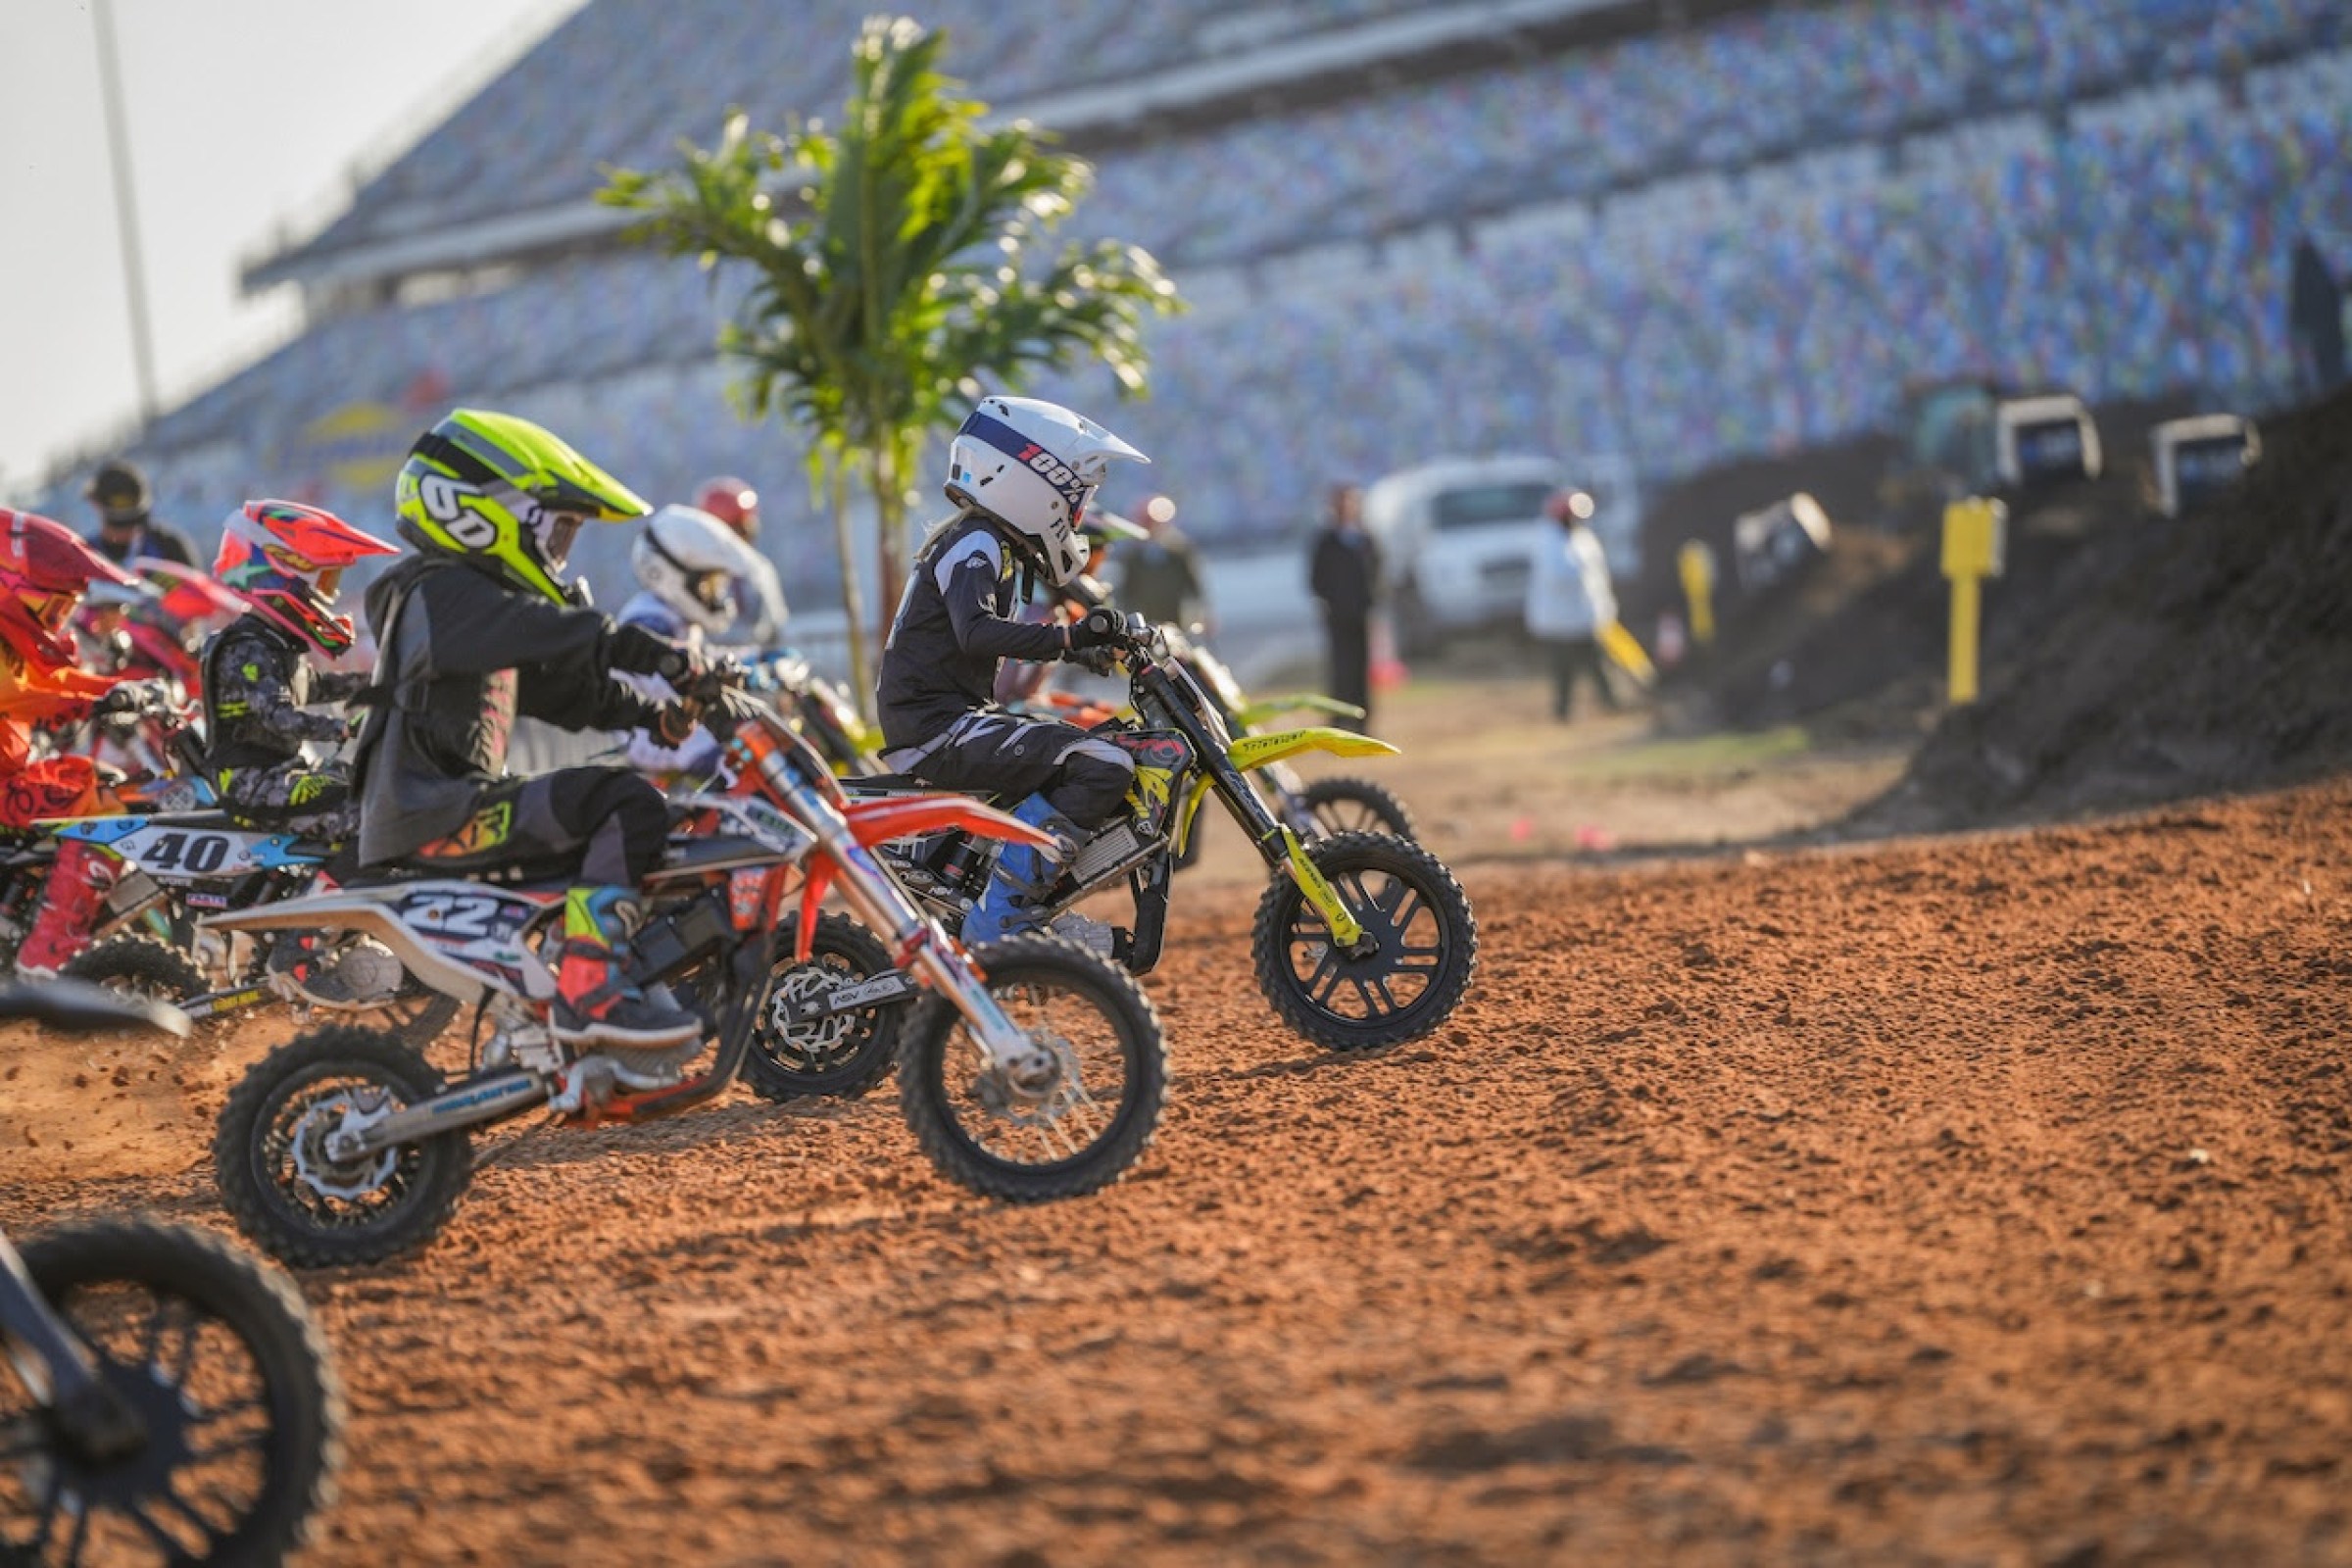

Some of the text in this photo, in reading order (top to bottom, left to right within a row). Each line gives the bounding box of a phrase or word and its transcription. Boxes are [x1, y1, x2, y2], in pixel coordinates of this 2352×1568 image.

[1017, 443, 1085, 504] 100%
[420, 473, 496, 547] 6D
[141, 832, 230, 872] 40
[402, 895, 500, 936] 22
